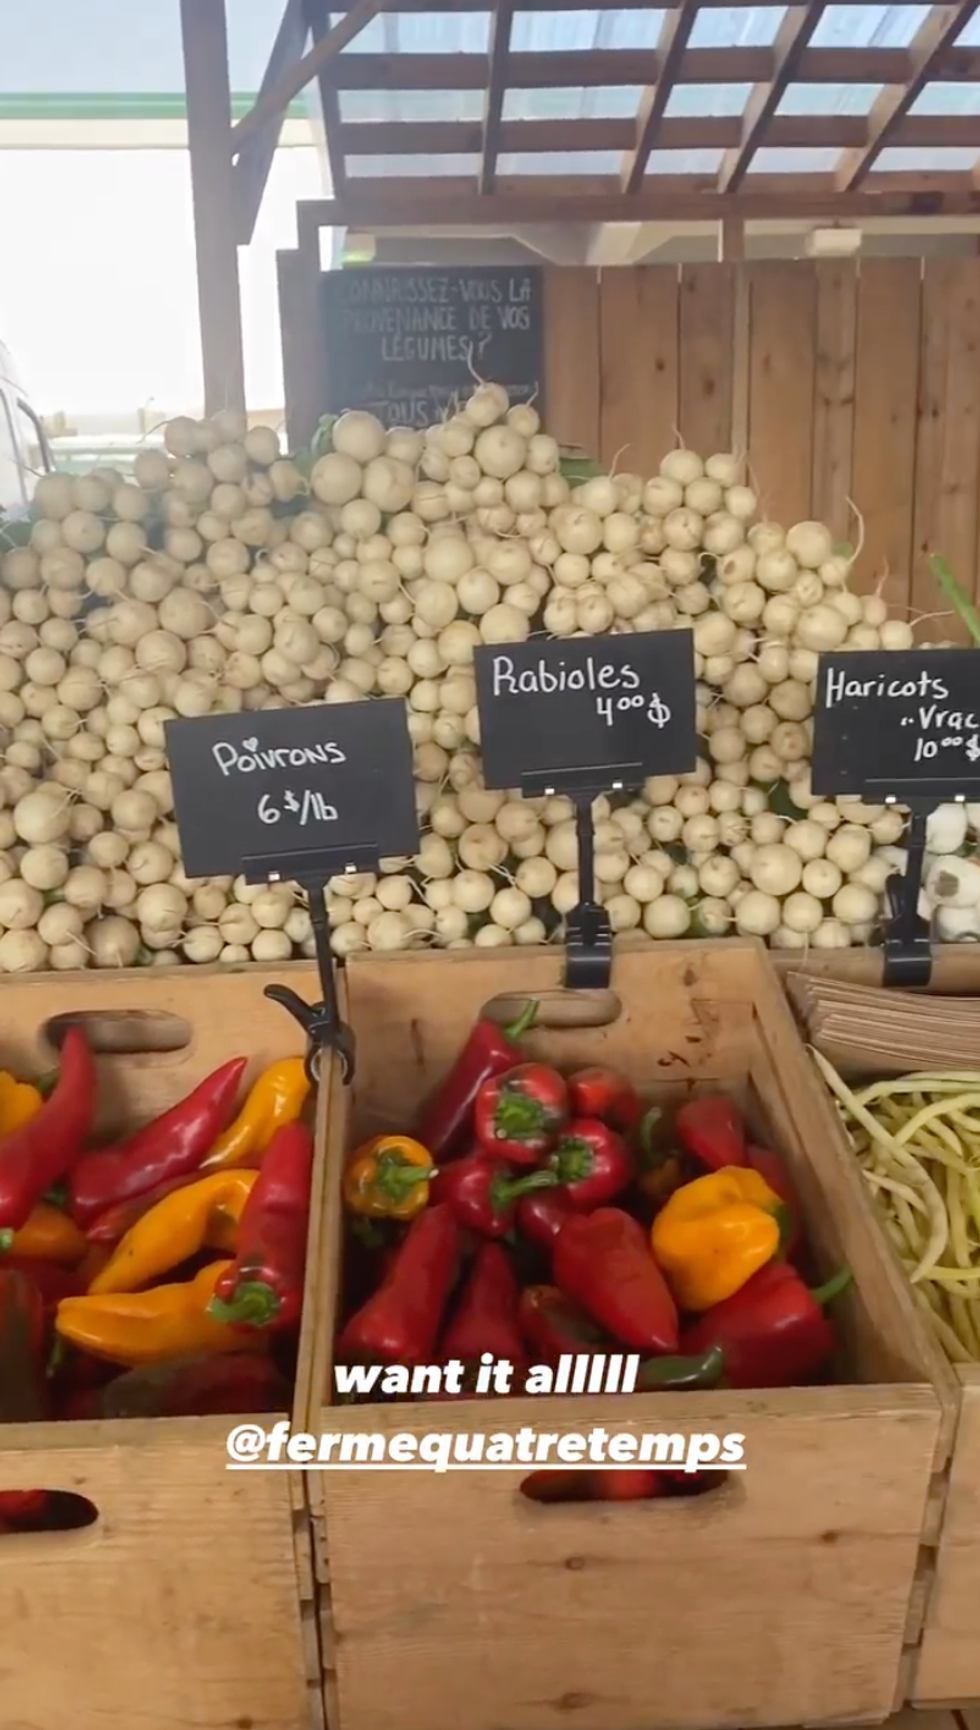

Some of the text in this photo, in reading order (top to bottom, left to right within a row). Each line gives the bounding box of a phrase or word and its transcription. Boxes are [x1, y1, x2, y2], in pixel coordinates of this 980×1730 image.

[508, 277, 531, 303] LA
[468, 304, 491, 331] DE
[496, 304, 530, 331] VOS
[493, 655, 640, 696] Rabioles
[826, 667, 949, 708] Haricots
[211, 737, 347, 776] Poivrons
